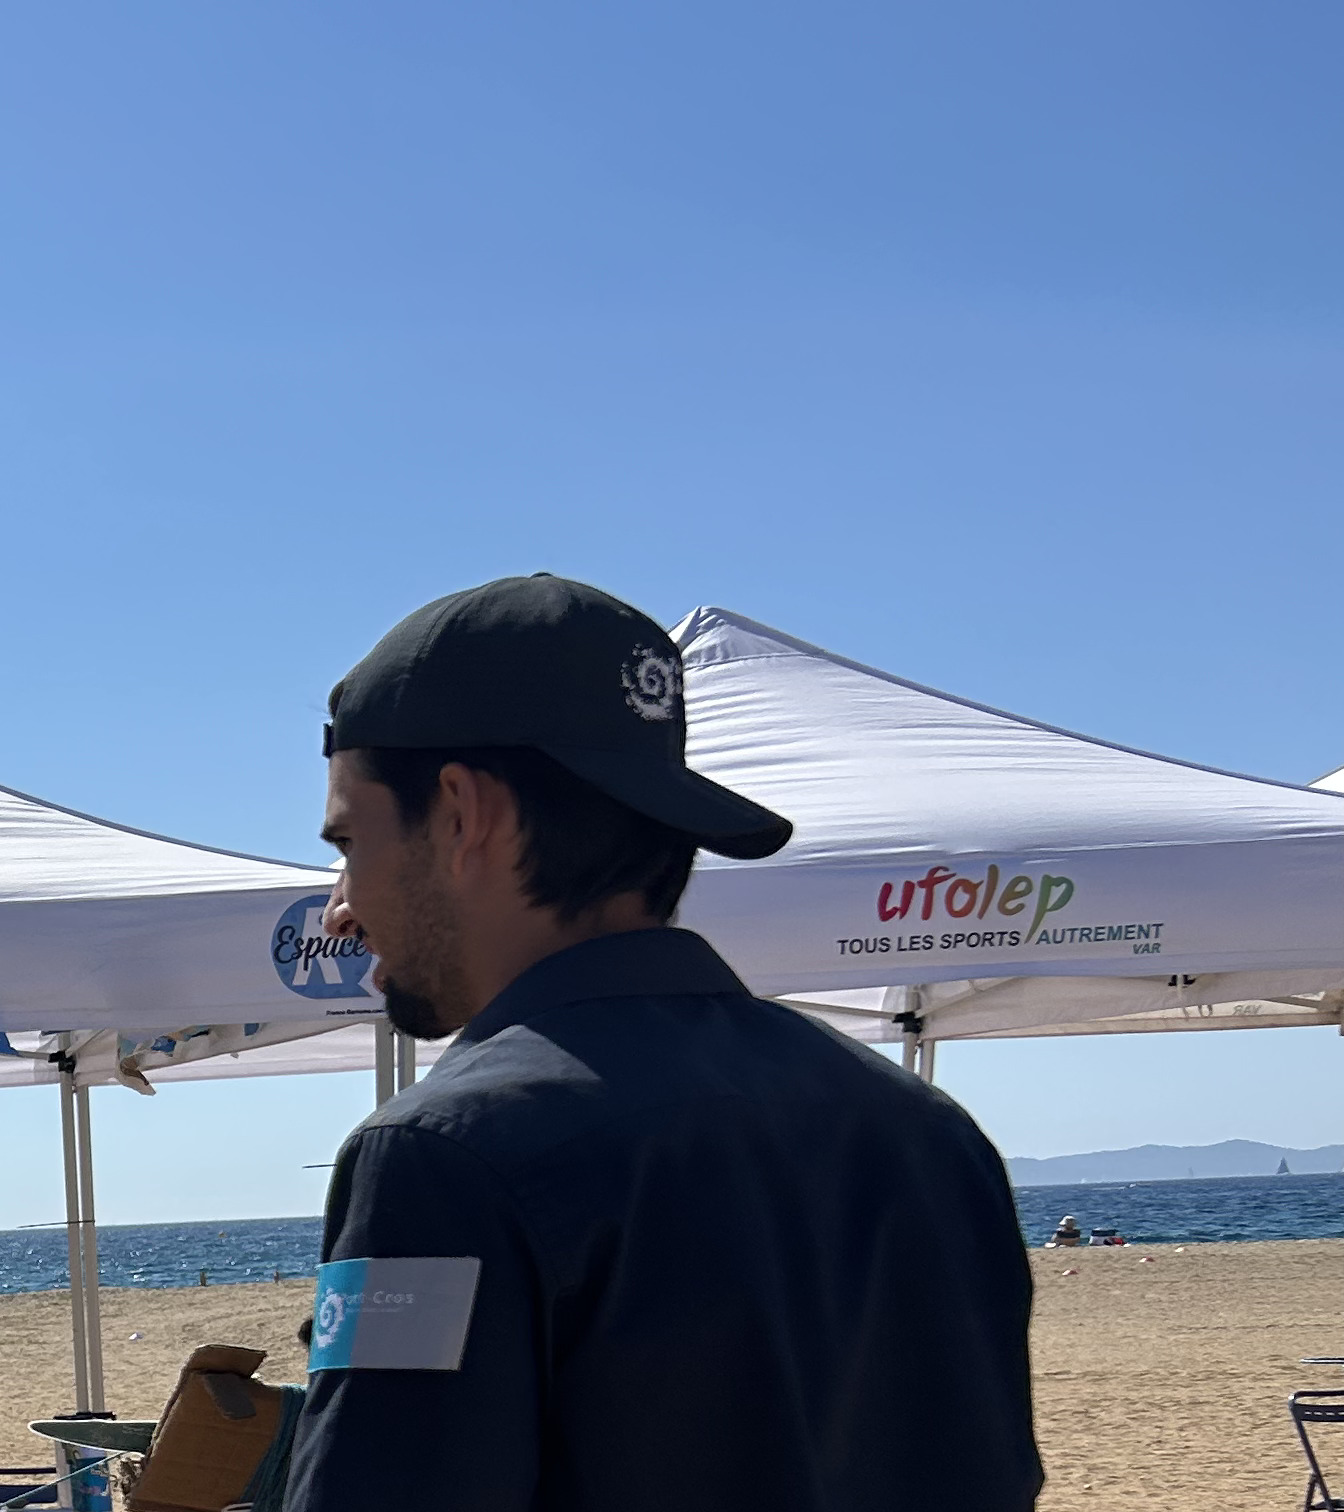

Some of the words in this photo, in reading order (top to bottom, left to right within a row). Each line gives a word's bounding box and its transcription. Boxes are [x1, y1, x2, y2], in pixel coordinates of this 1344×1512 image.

[877, 863, 1074, 944] ufolep
[273, 925, 367, 971] Espace
[837, 937, 891, 955] TOUS
[897, 935, 934, 952] LES
[940, 931, 1021, 949] SPORTS
[1036, 923, 1164, 945] AUTREMENT
[1133, 942, 1161, 954] VAR
